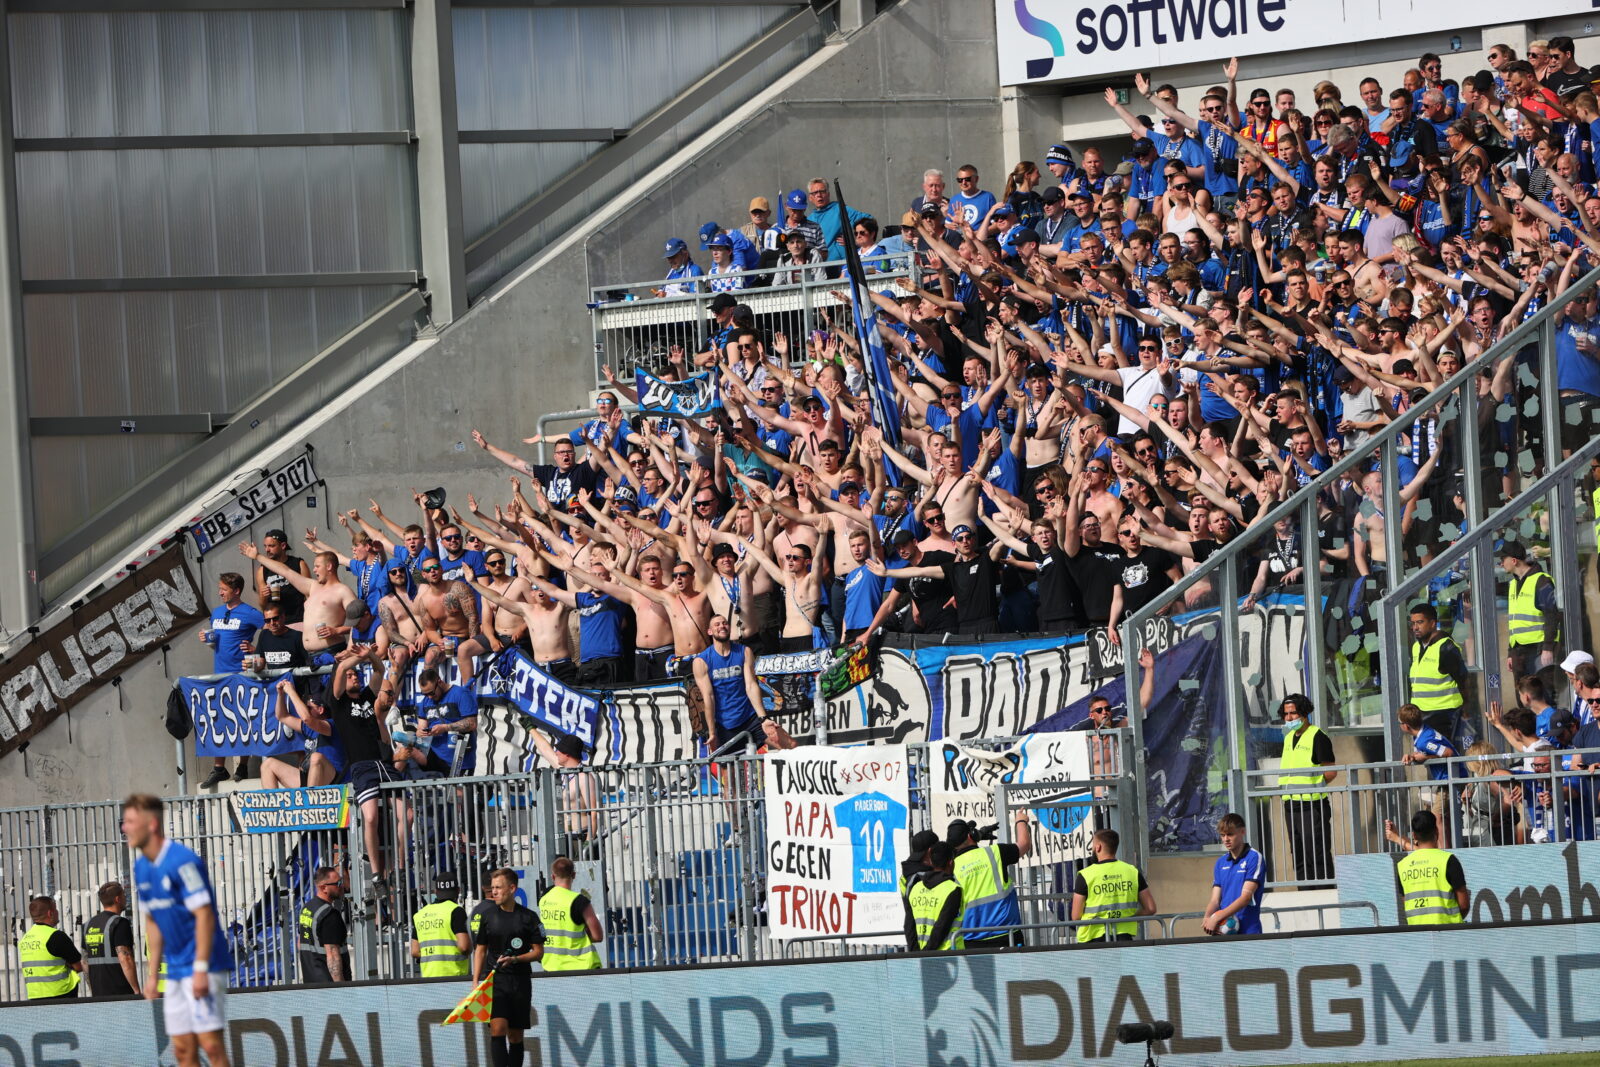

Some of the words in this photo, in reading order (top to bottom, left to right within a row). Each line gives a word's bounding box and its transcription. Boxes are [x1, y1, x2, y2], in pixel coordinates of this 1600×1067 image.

[202, 512, 231, 544] PB
[239, 489, 267, 520] SC
[267, 457, 310, 505] 1907
[771, 759, 843, 796] TAUSCHE
[237, 791, 291, 808] SCHNAPS
[295, 790, 303, 806] &
[306, 788, 341, 805] WEED
[784, 801, 834, 840] PAPA
[860, 819, 885, 862] 10
[770, 840, 831, 880] GEGEN
[1402, 866, 1439, 882] ORDNER
[1093, 880, 1133, 895] ORDNER
[541, 909, 566, 922] RDNER
[771, 884, 857, 935] TRIKOT
